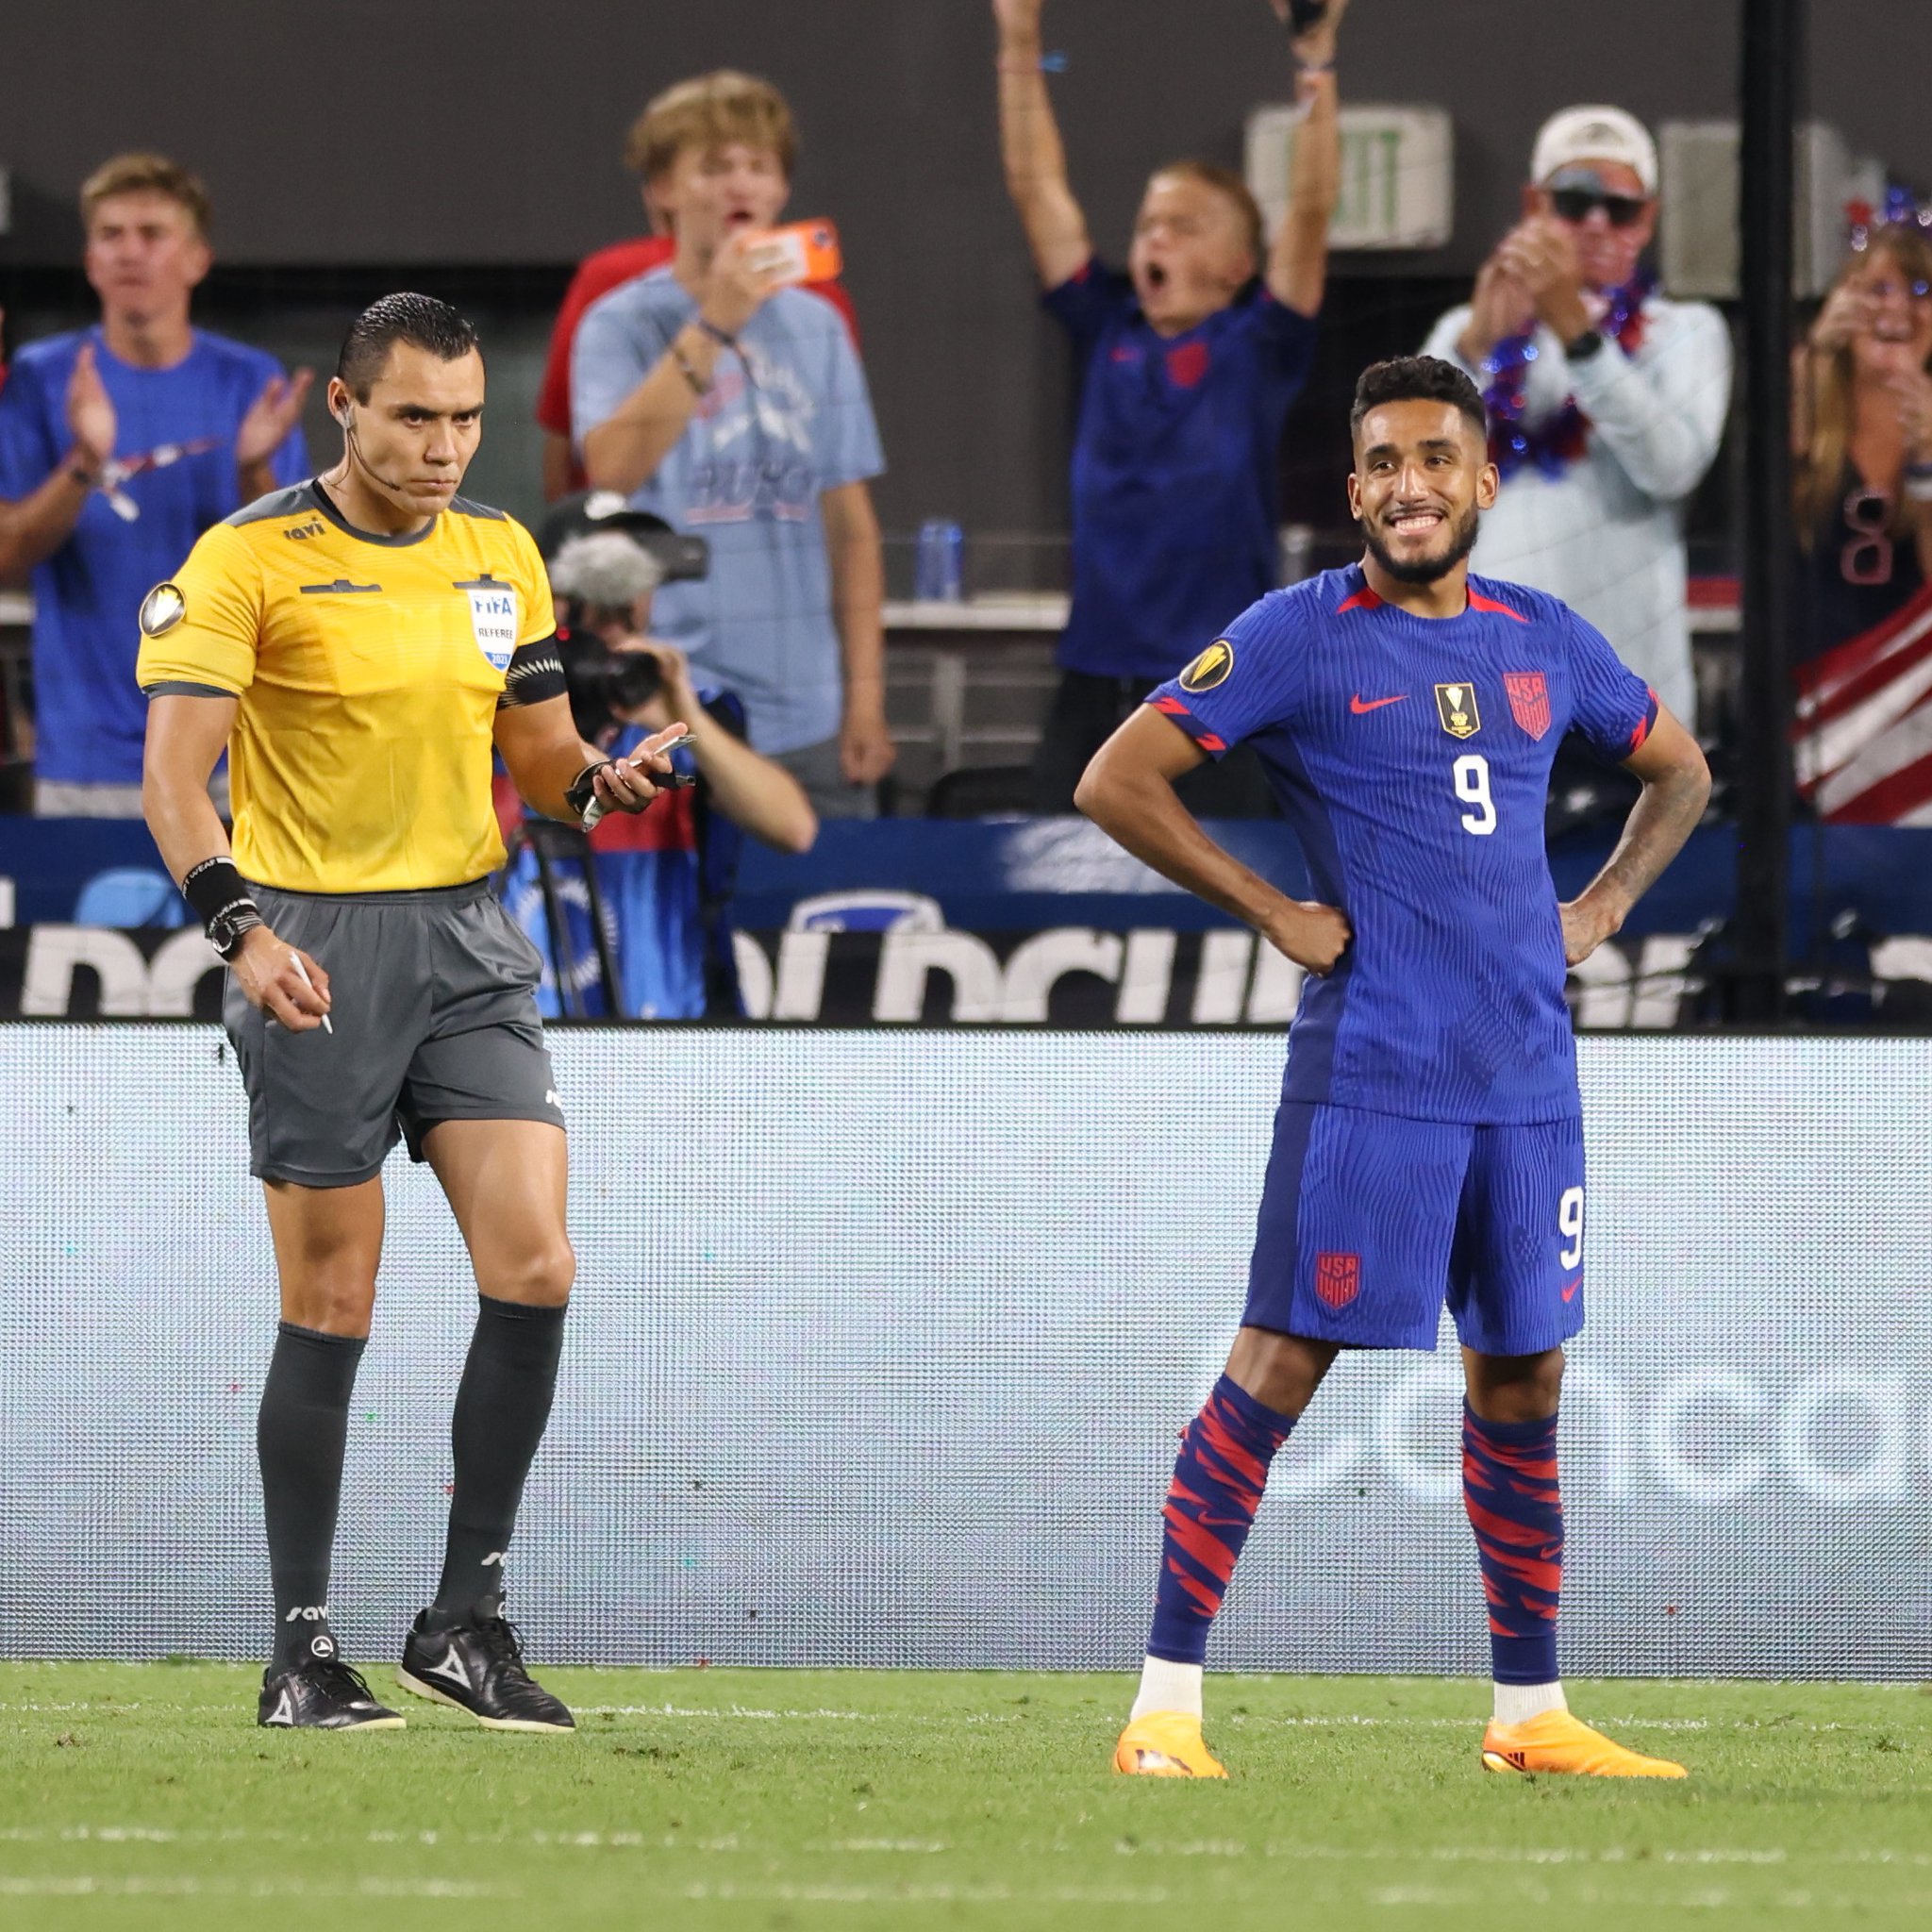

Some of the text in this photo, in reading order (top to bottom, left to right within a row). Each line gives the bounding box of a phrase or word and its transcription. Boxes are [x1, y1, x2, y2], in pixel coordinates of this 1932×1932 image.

[475, 597, 512, 615] FIFA
[478, 627, 513, 640] REFEREE
[1507, 677, 1545, 702] USA
[1453, 755, 1496, 835] 9
[1559, 1185, 1584, 1271] 9
[1321, 1256, 1357, 1277] USA
